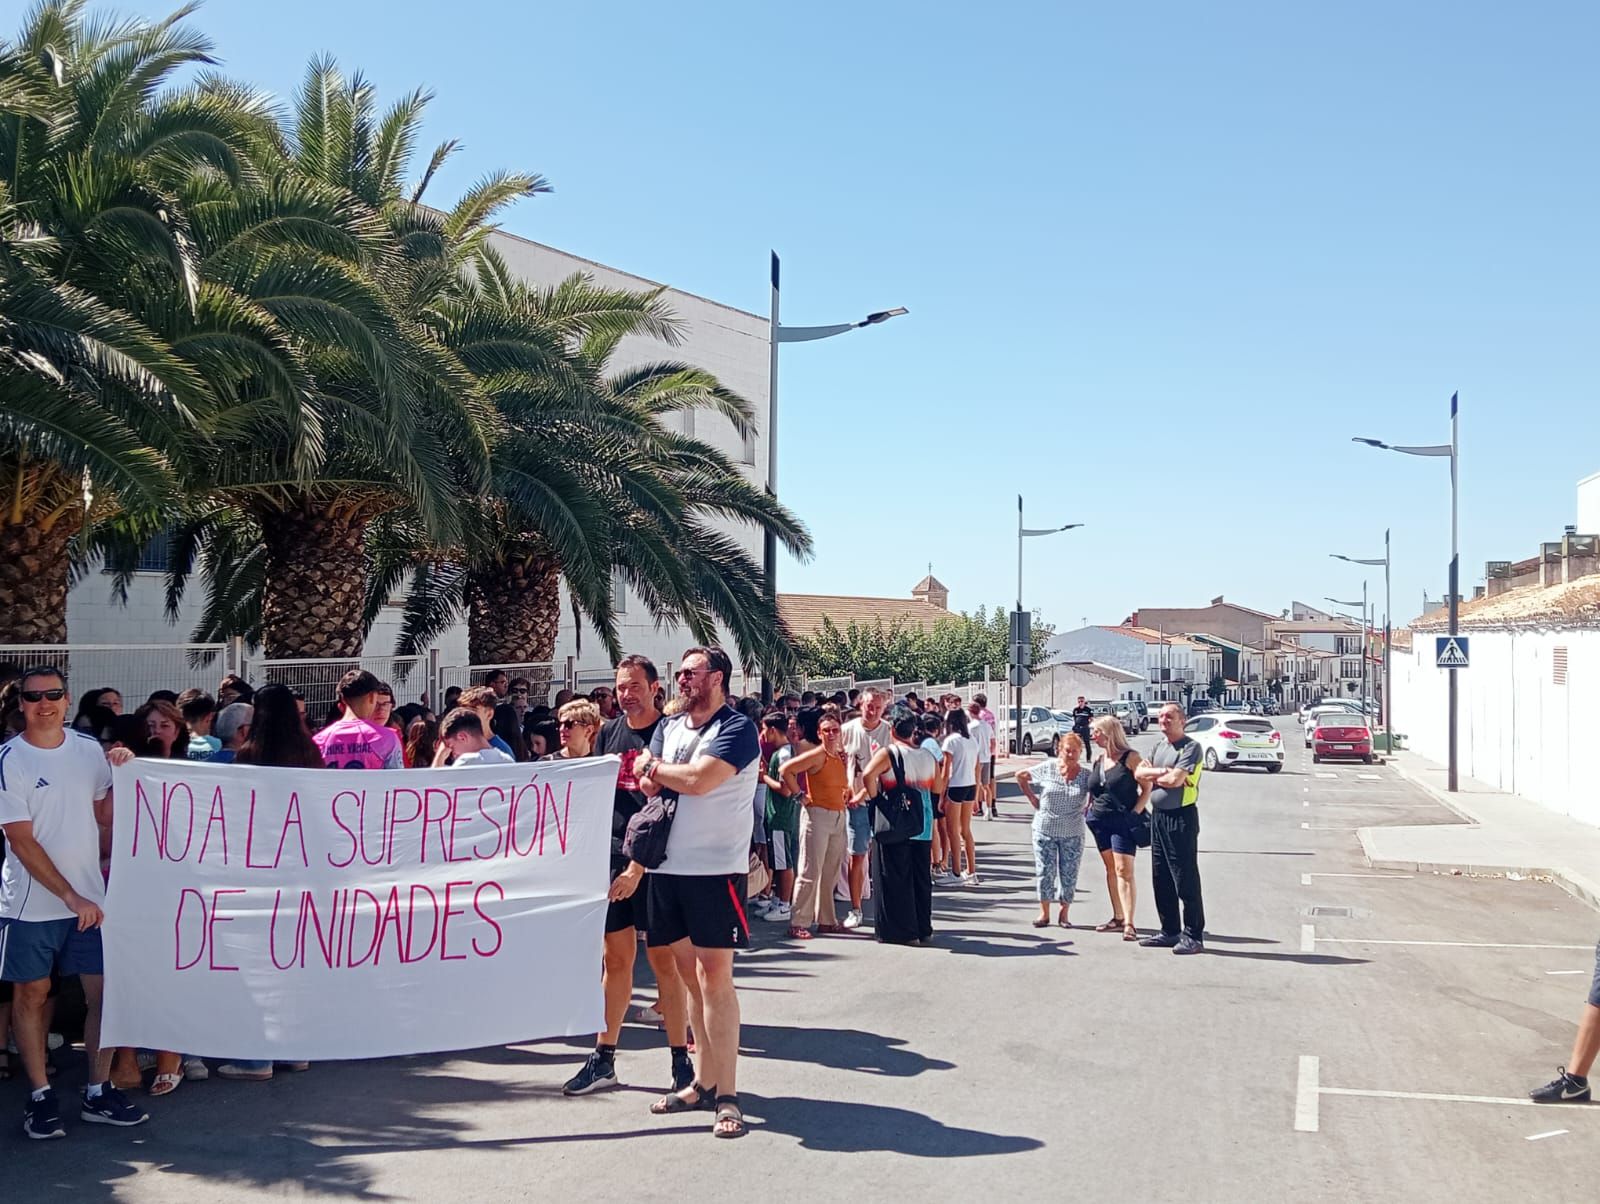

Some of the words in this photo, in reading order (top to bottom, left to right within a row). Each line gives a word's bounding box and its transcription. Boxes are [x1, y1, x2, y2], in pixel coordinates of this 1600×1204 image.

[132, 779, 194, 862] NO
[198, 785, 228, 865] A
[246, 789, 309, 868] LA
[327, 773, 573, 869] SUPRESIÓN
[175, 888, 246, 971] DE
[270, 880, 505, 971] UNIDADES
